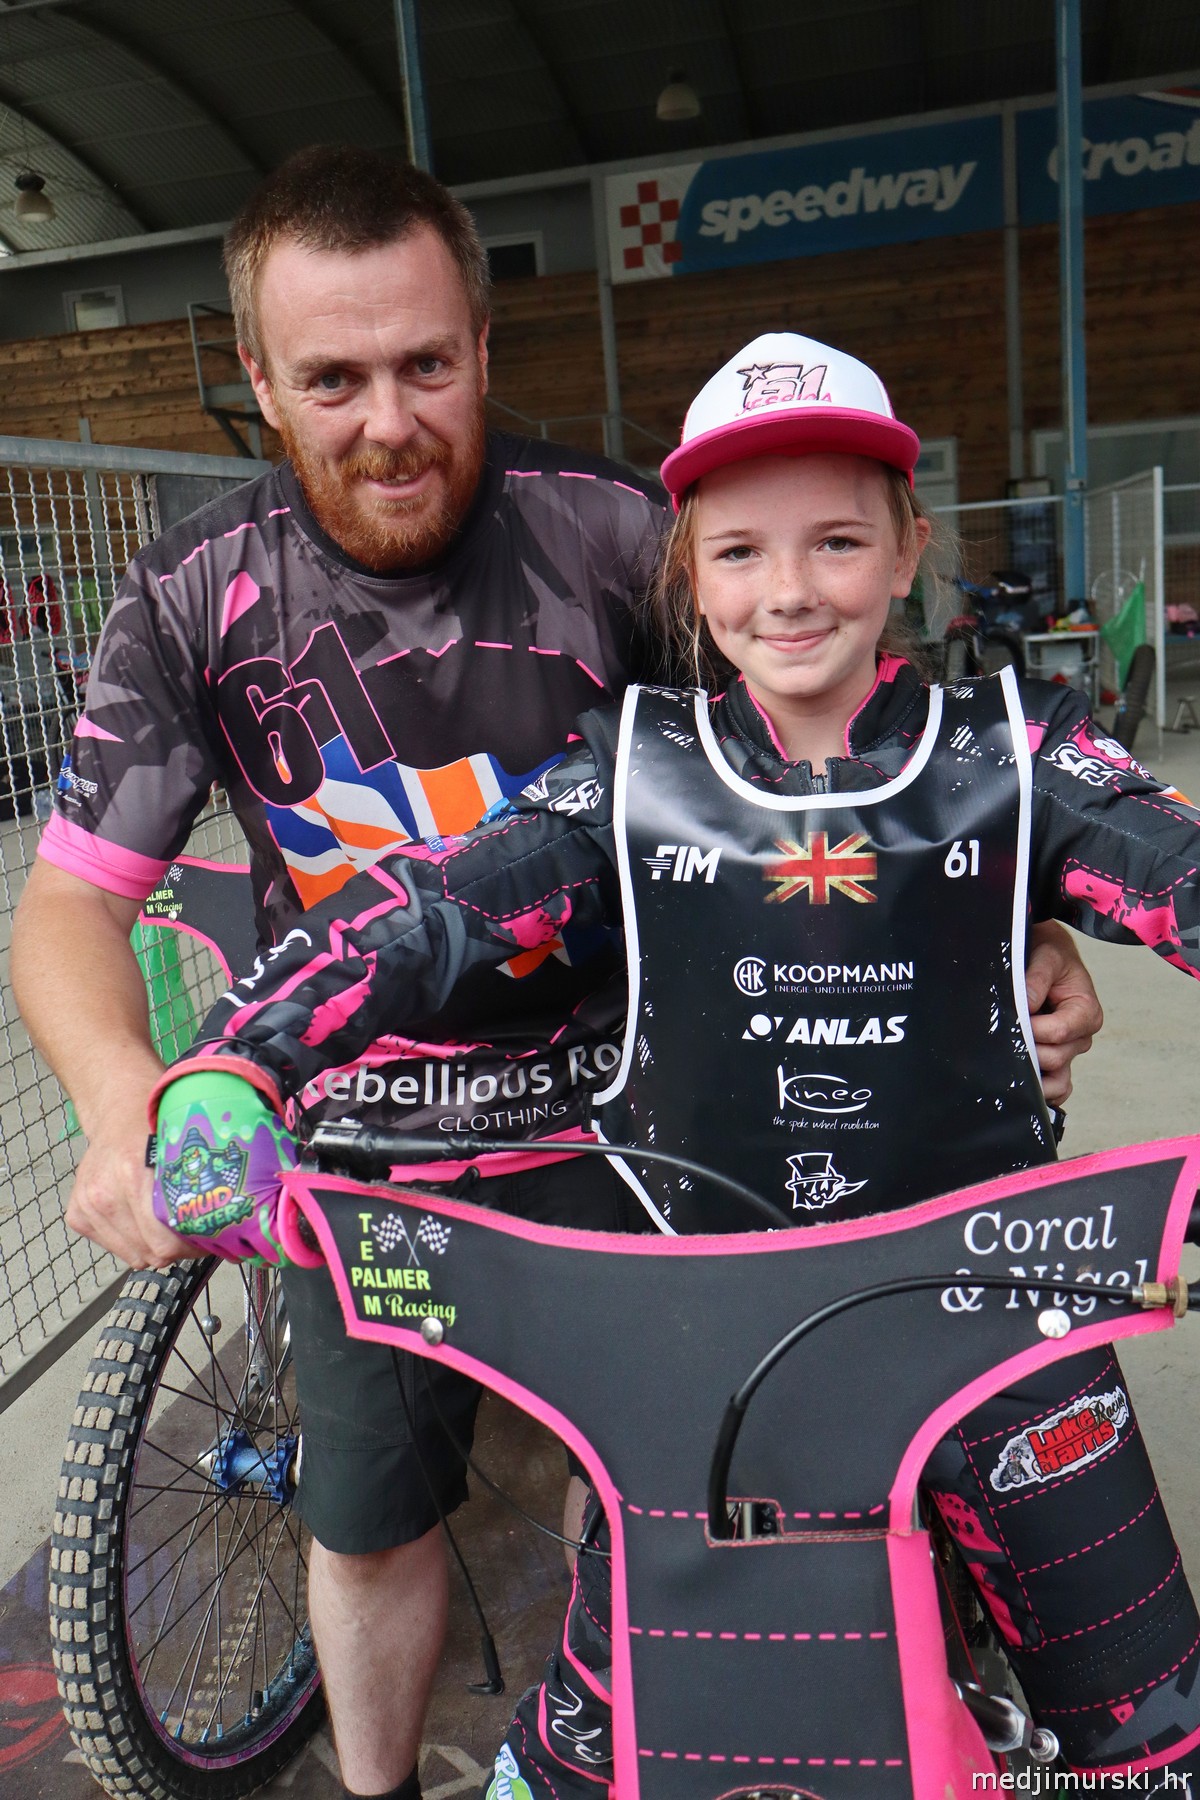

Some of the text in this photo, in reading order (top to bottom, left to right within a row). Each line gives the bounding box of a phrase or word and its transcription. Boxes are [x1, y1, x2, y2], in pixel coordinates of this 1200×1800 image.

[699, 161, 977, 243] speedway
[217, 620, 397, 809] 61
[645, 845, 722, 884] FIM
[944, 839, 980, 879] 61
[155, 902, 183, 914] Racing
[774, 961, 914, 984] KOOPMANN
[785, 1015, 908, 1045] ANLAS
[569, 1039, 626, 1086] Ro
[777, 1064, 872, 1114] Kineo
[438, 1100, 568, 1133] CLOTHING
[773, 1116, 880, 1132] the spoke wheel revolution
[177, 1186, 233, 1222] MUD
[964, 1205, 1117, 1255] Coral
[351, 1267, 431, 1291] PALMER
[940, 1259, 1148, 1316] & Nigel
[385, 1293, 458, 1327] Racing
[1027, 1407, 1099, 1455] Luke
[1037, 1419, 1117, 1475] Harris
